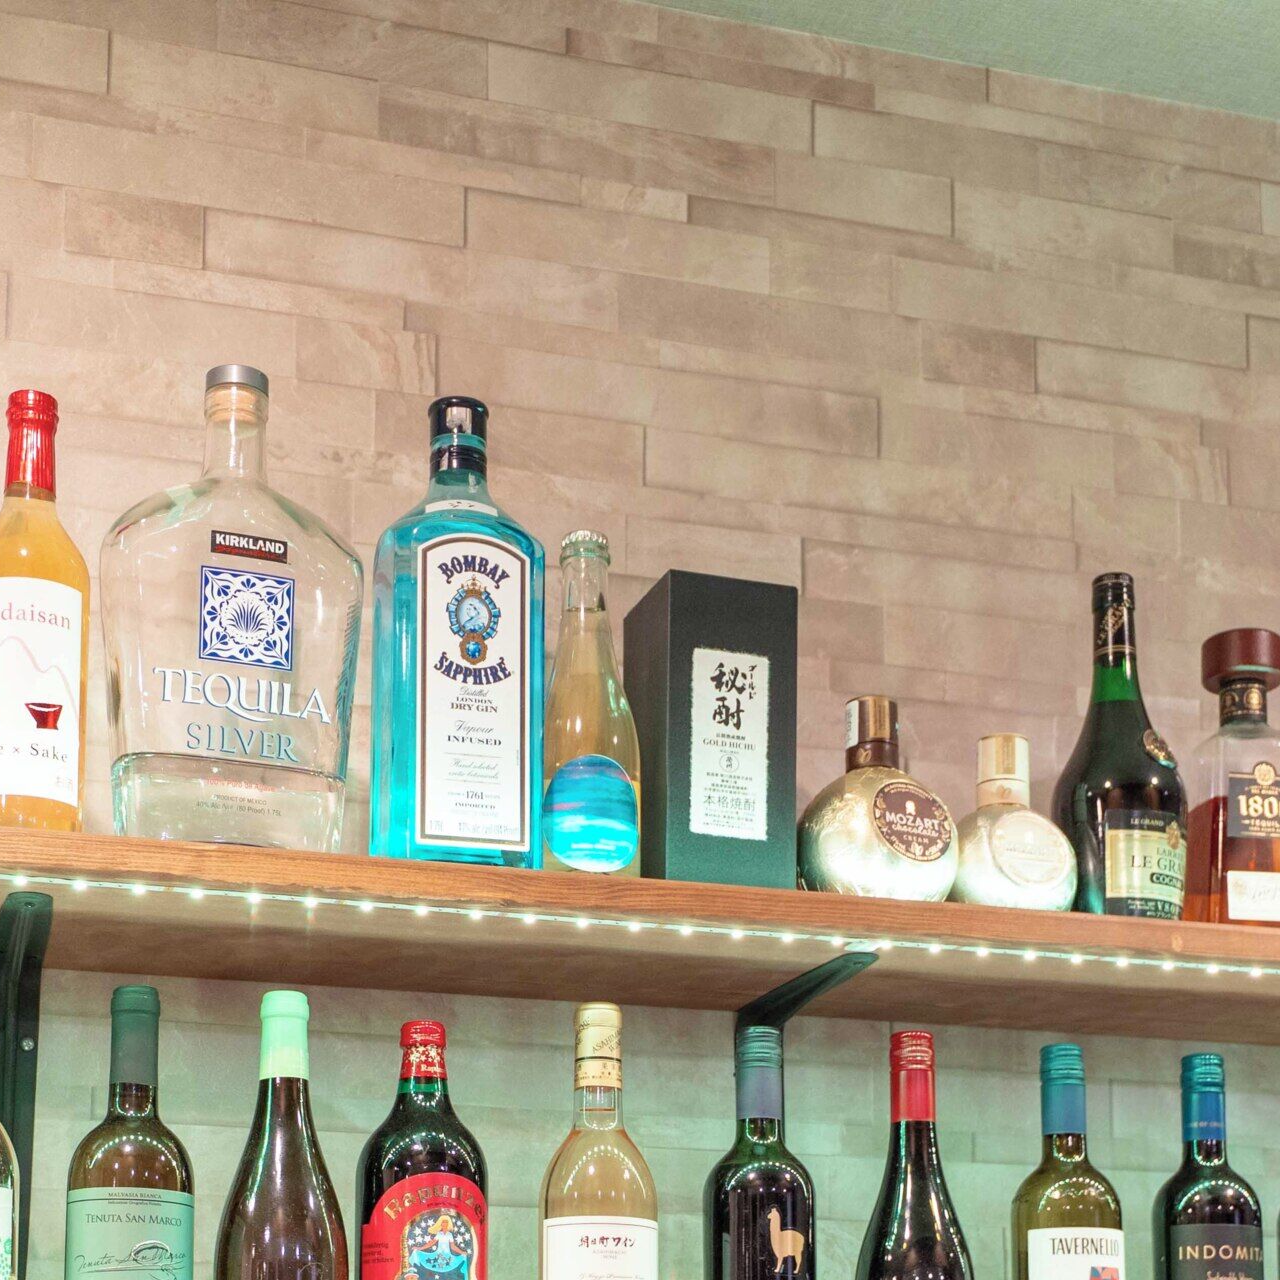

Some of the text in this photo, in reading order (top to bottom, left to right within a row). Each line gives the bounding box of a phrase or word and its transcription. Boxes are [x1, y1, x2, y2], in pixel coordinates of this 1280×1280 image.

[215, 532, 285, 554] KIRKLAND
[437, 554, 511, 589] BOMBAY
[433, 651, 513, 686] SAPPHIRE
[152, 667, 332, 724] TEQUILA
[456, 696, 494, 705] LONDON
[450, 702, 499, 713] DRY GIN
[455, 719, 494, 735] Vapour
[185, 722, 300, 762] SILVER
[447, 734, 503, 747] INFUSED
[702, 738, 727, 747] GOLD
[29, 742, 69, 763] Sake
[465, 790, 485, 800] 1761
[703, 794, 756, 812] 本格焼酎
[885, 810, 941, 831] MOZART
[1131, 855, 1152, 869] LE
[107, 1191, 162, 1200] MALVASIA BIANCA
[85, 1212, 182, 1227] TENUTA SAN MARCO
[578, 1235, 636, 1248] 朝日町ワイン
[1049, 1237, 1121, 1257] TAVERNELLO
